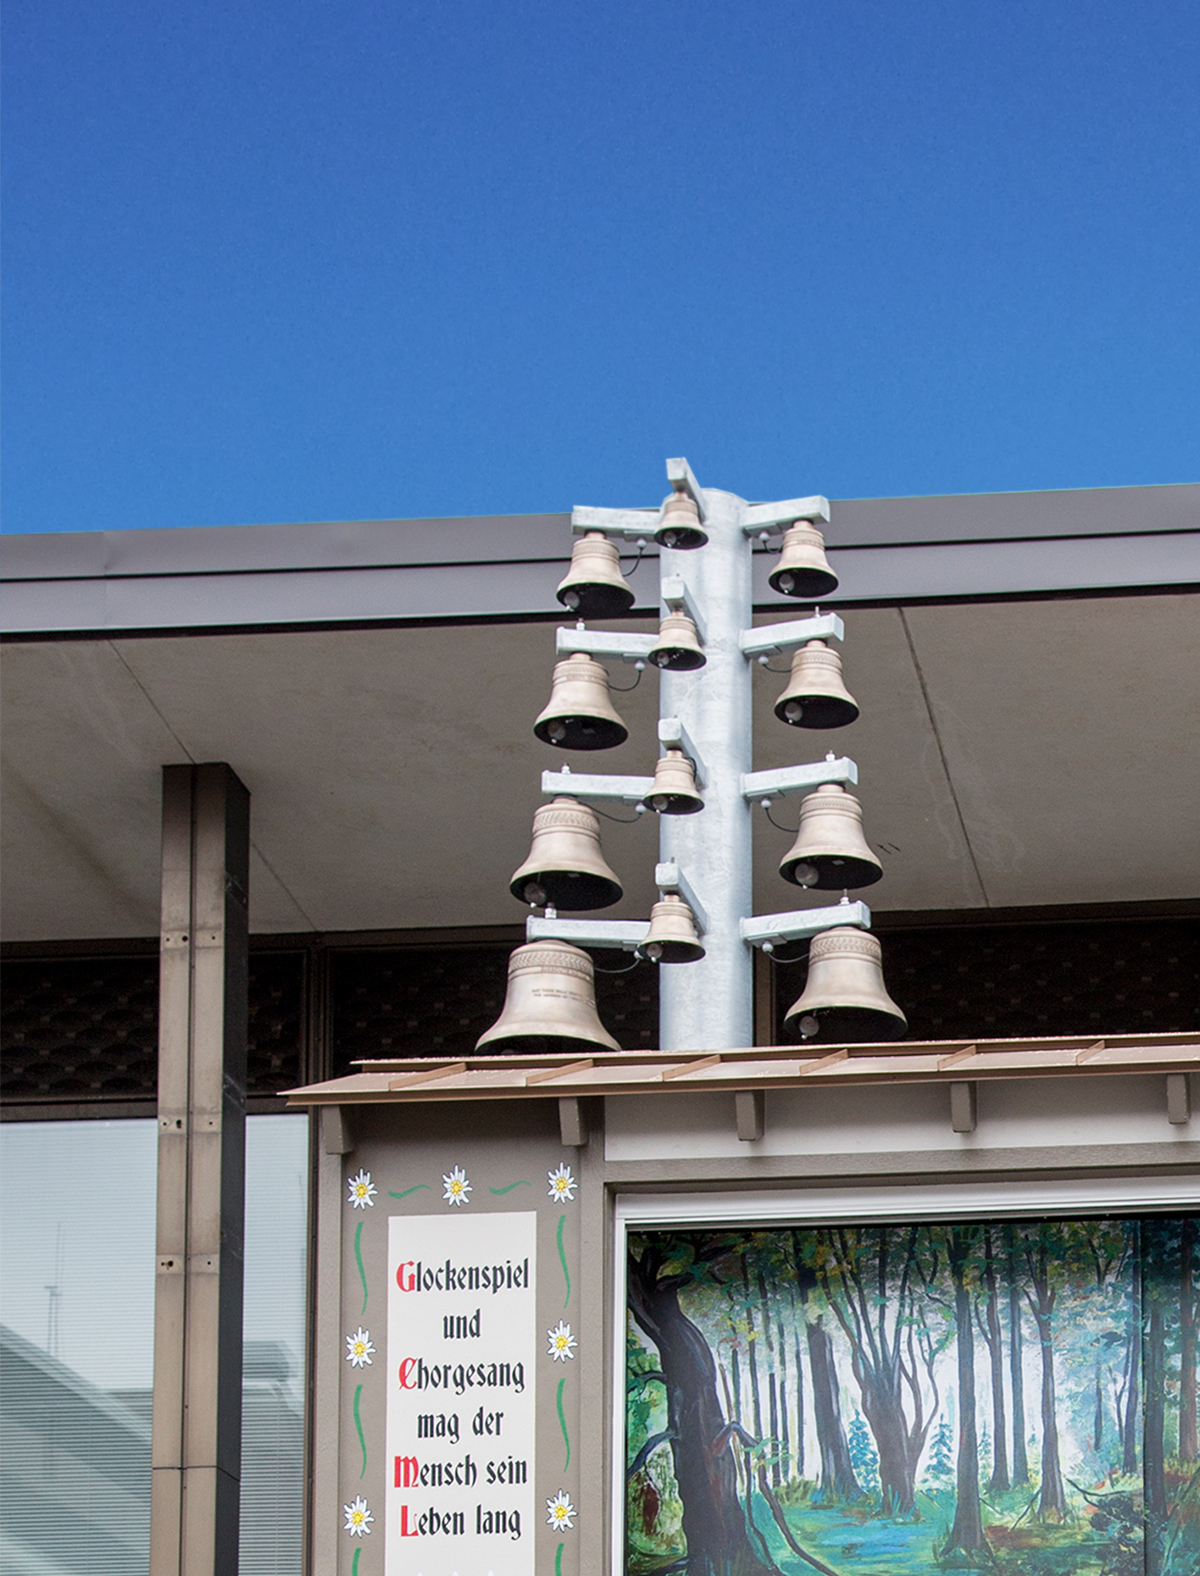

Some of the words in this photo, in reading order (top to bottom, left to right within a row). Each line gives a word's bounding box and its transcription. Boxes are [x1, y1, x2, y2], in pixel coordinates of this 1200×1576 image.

[396, 1257, 529, 1296] Glockenspiel
[443, 1308, 481, 1340] und
[398, 1355, 525, 1396] Chorgesang
[417, 1413, 460, 1445] mag
[472, 1407, 504, 1435] der
[394, 1454, 477, 1489] Mensch
[486, 1454, 528, 1486] sein
[400, 1503, 465, 1538] Leben
[475, 1502, 522, 1541] lang
